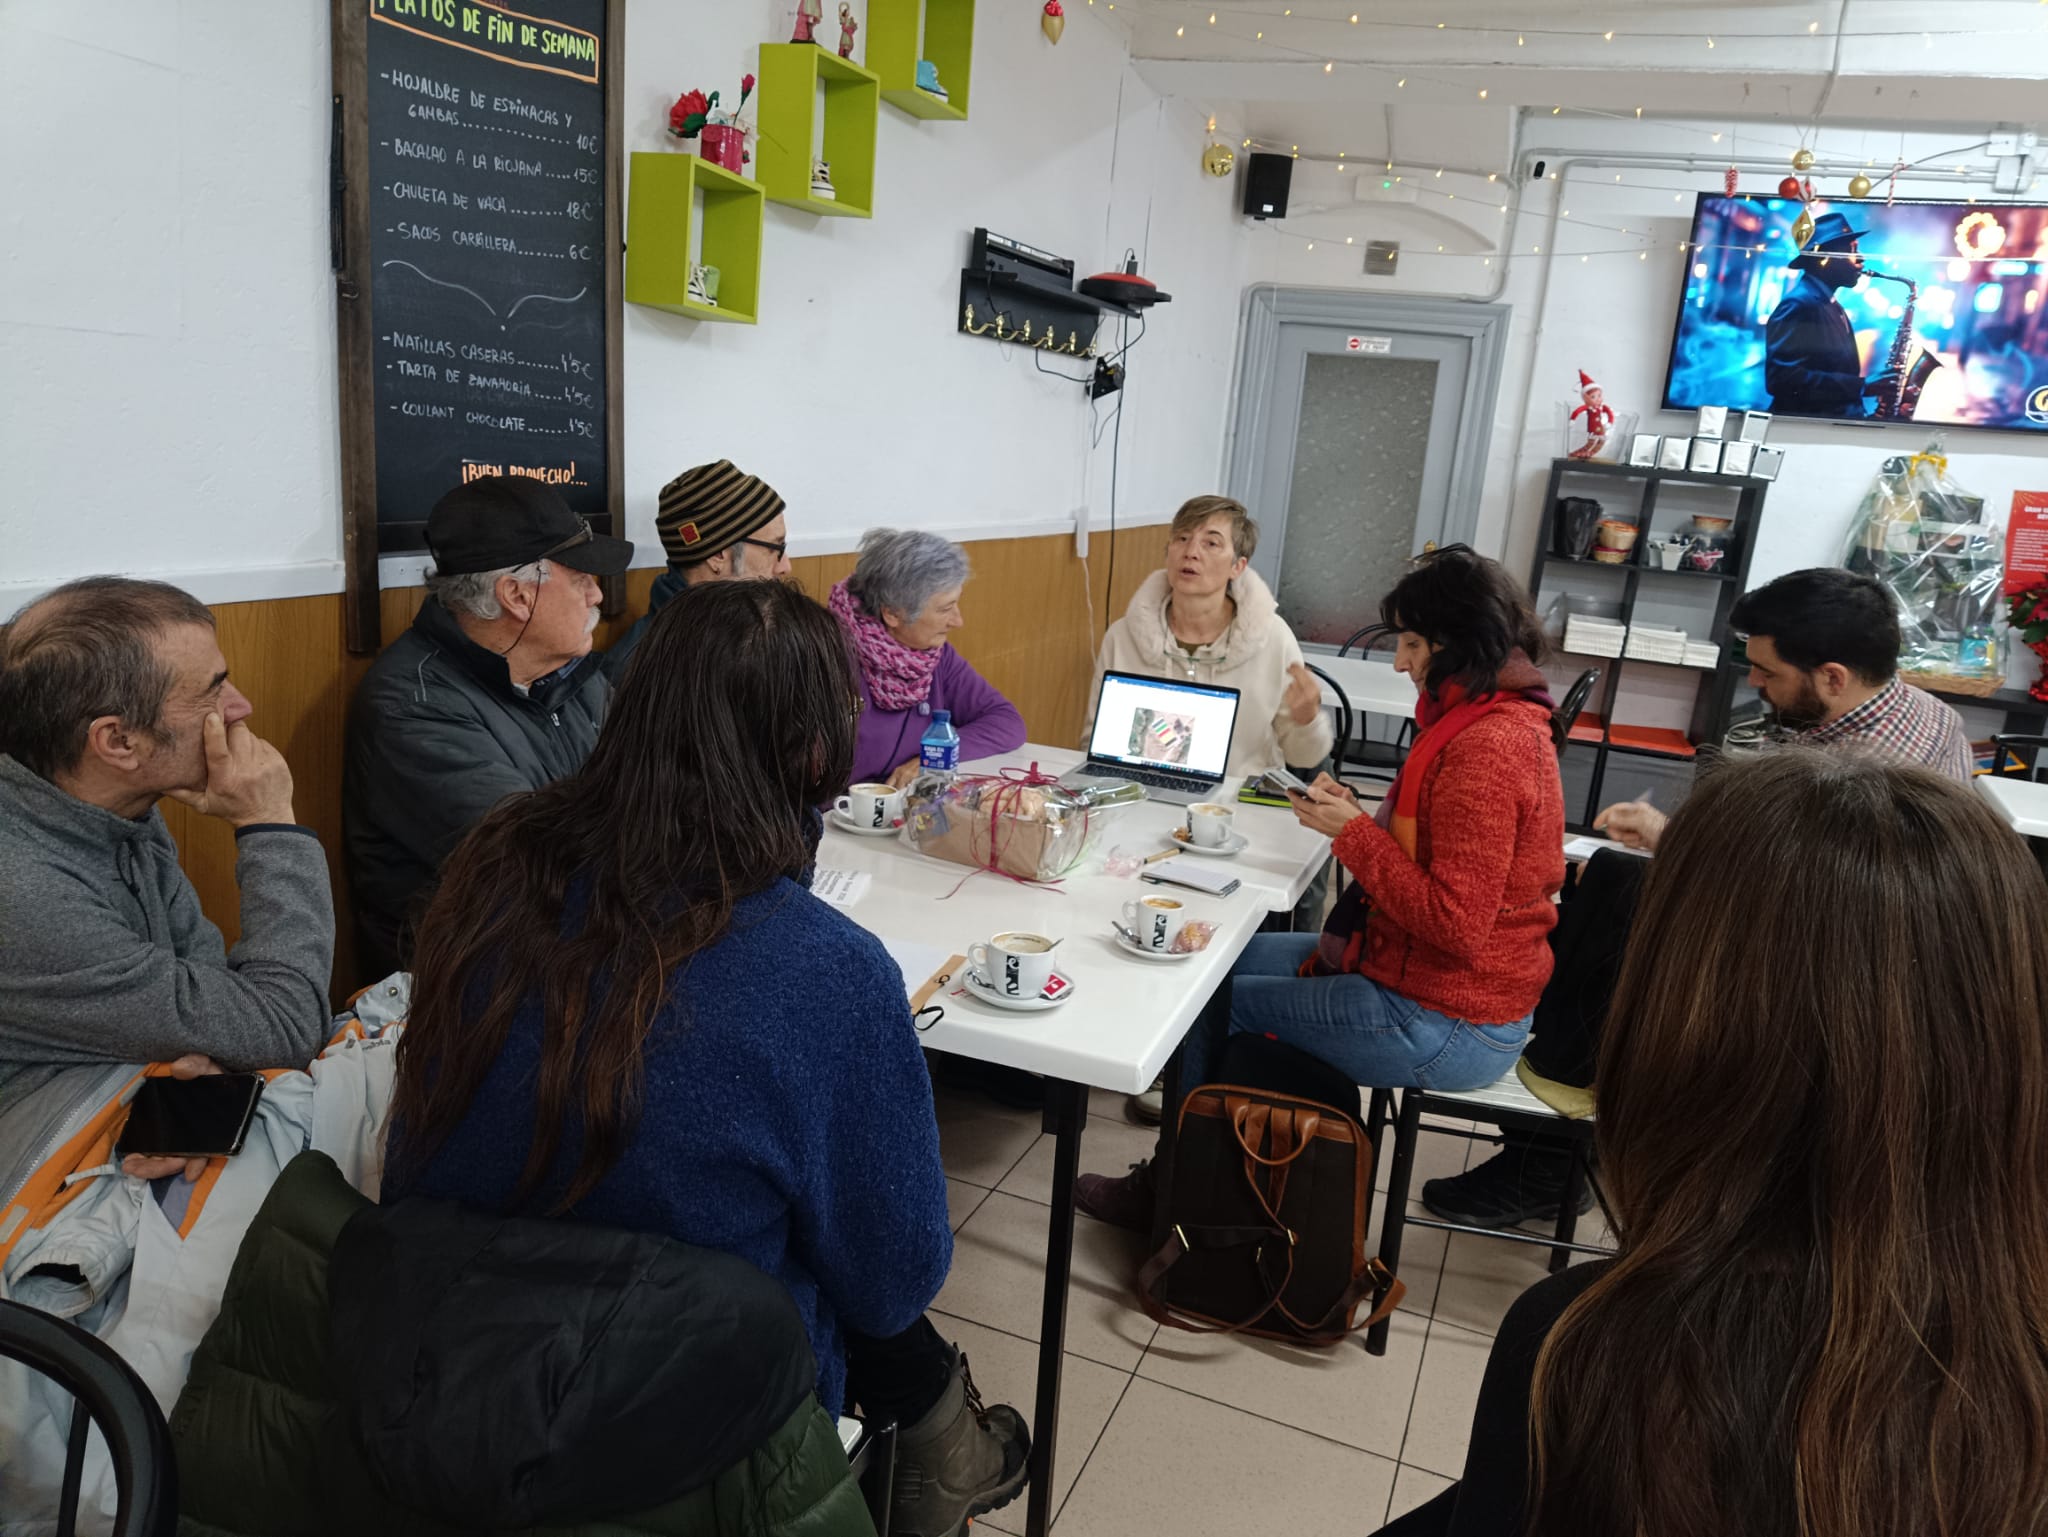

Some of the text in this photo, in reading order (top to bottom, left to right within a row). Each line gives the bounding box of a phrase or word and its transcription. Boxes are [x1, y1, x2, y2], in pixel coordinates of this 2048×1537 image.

[463, 8, 481, 34] DE
[488, 14, 514, 43] FIN
[521, 26, 538, 47] DE
[541, 30, 596, 62] SEMANA
[471, 89, 486, 109] DE
[493, 97, 559, 126] ESPINACAS
[565, 113, 572, 128] Y
[456, 148, 465, 166] A
[473, 153, 487, 170] LA
[453, 192, 469, 210] DE
[446, 368, 460, 383] DE
